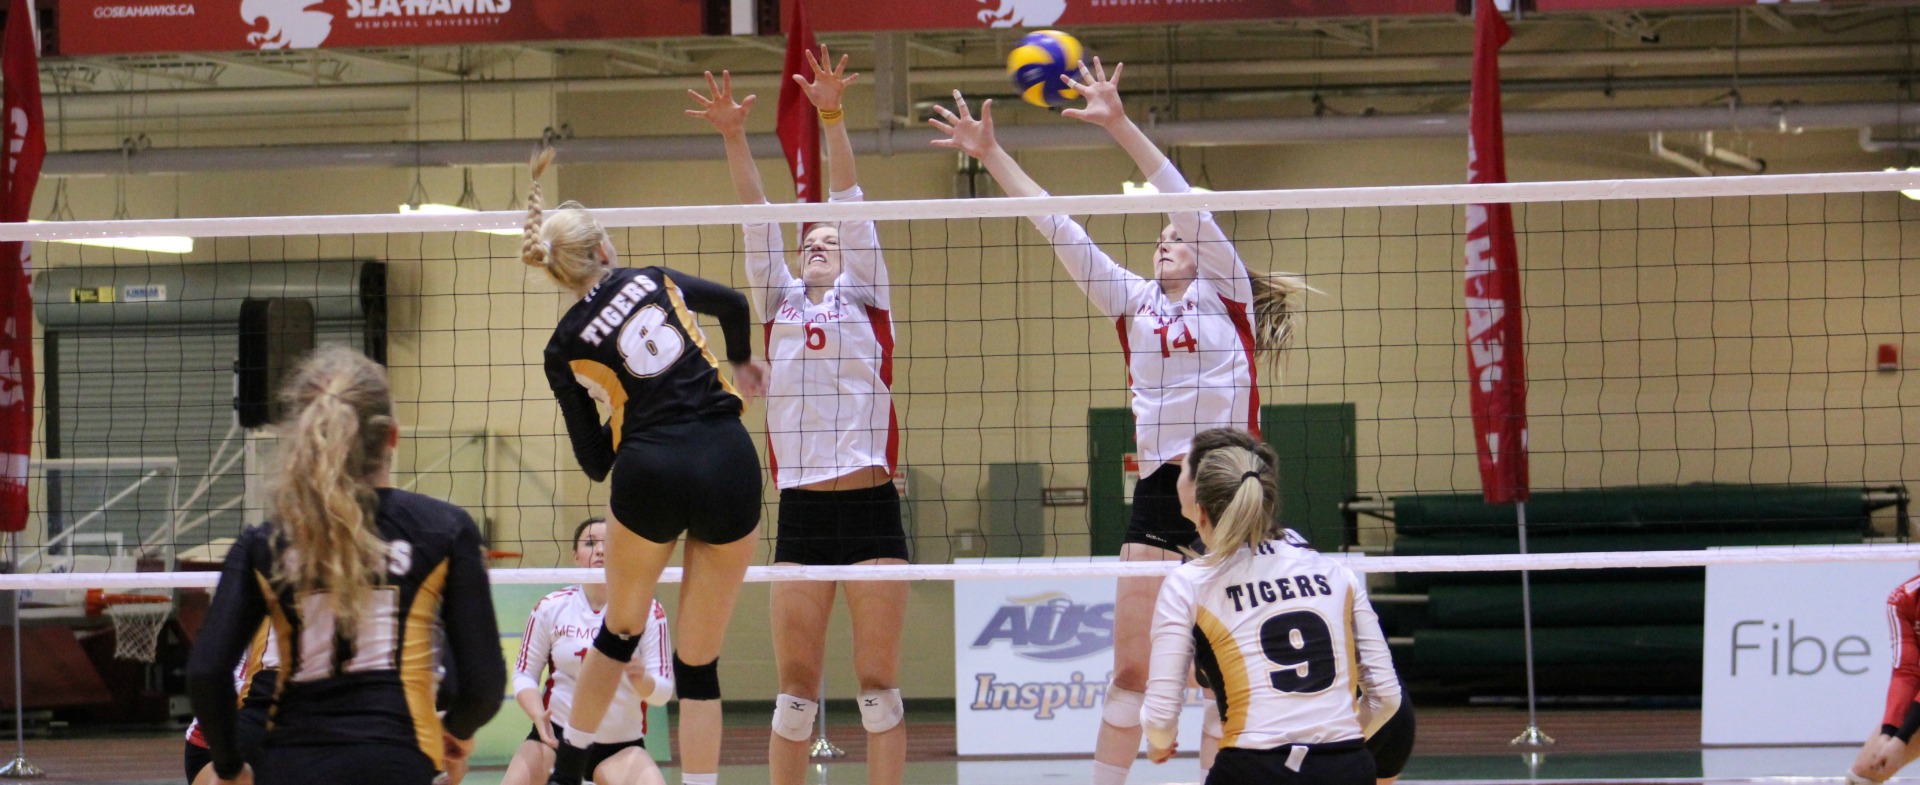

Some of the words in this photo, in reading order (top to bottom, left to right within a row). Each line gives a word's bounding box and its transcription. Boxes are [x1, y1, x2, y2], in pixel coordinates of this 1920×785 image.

[94, 4, 195, 18] GOSEAHAWKS.CA
[354, 20, 419, 29] MEMORIAL
[426, 17, 500, 27] UNIVERSITY
[579, 274, 658, 348] TIGERS
[804, 321, 826, 350] 6
[1153, 322, 1198, 358] 14
[1225, 573, 1332, 612] TIGERS
[1257, 608, 1338, 696] 9
[1730, 619, 1872, 677] Fibe
[970, 671, 1113, 720] Inspir
